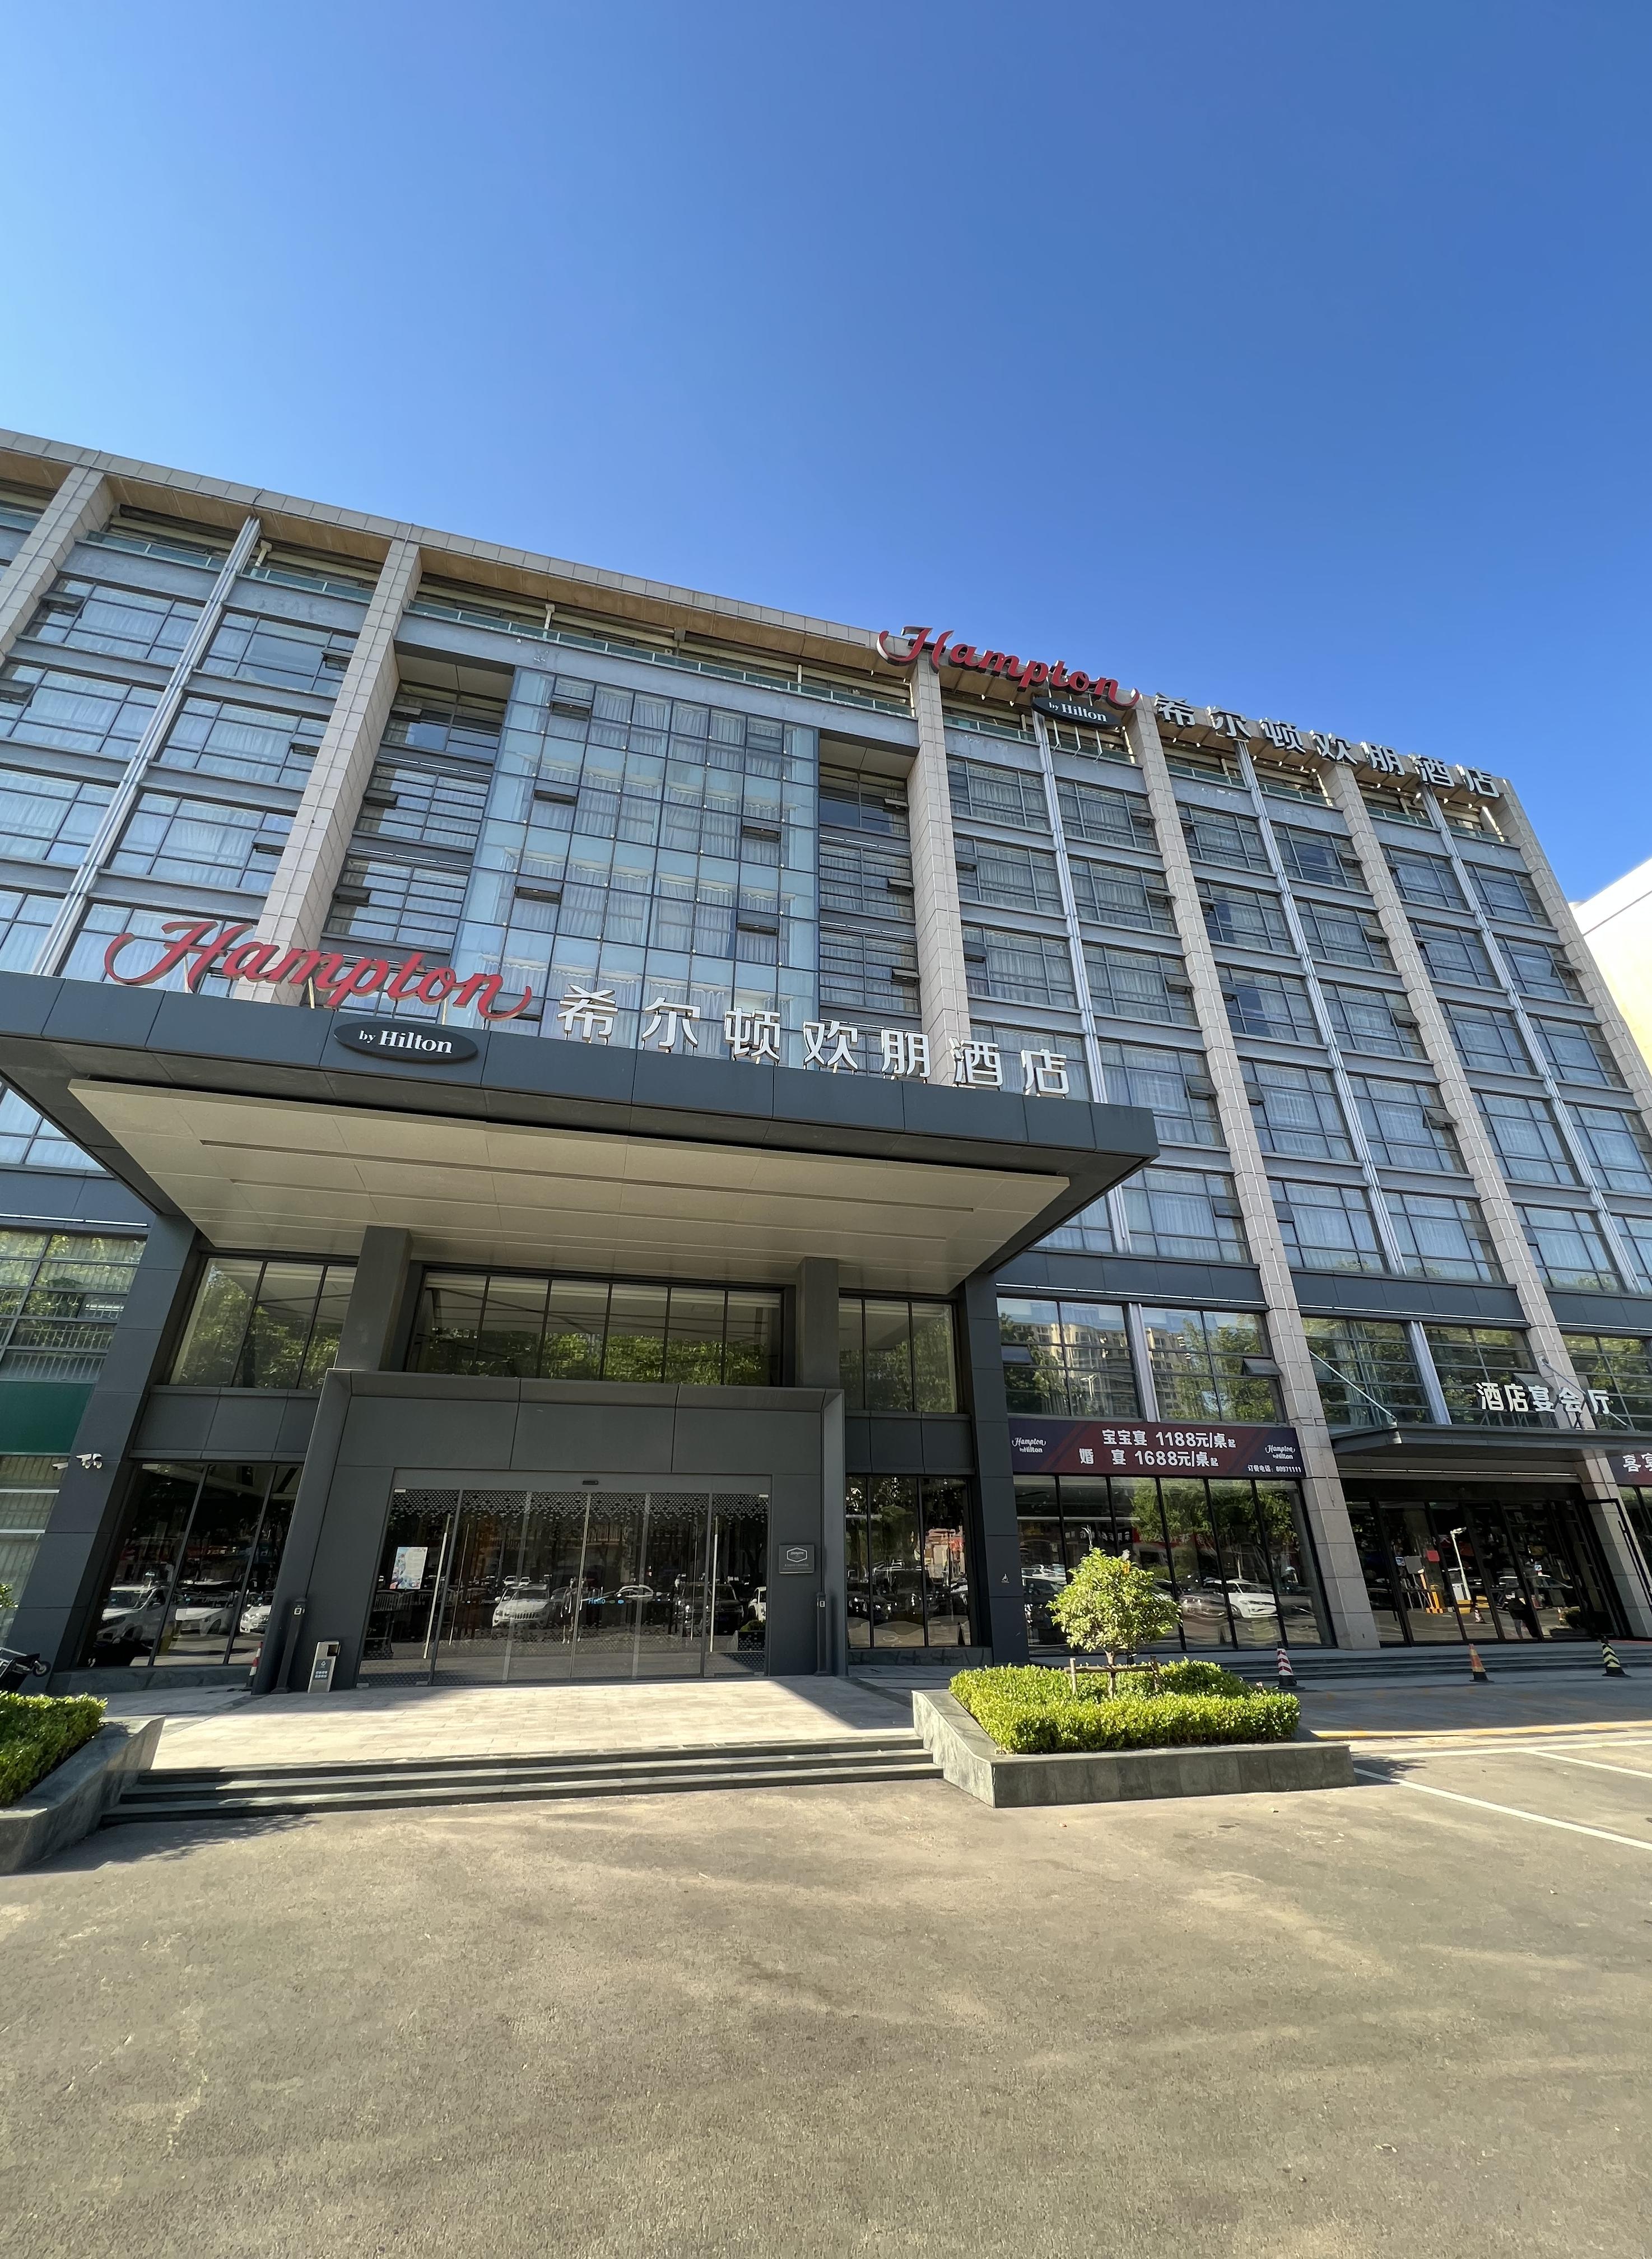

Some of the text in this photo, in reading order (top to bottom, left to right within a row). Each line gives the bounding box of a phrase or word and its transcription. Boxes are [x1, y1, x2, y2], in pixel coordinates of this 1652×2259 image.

[876, 626, 1140, 710] Hampton
[1049, 701, 1107, 722] by Hilton
[1154, 692, 1500, 798] 希尔顿欢朋酒店
[104, 921, 532, 1021] Hampton
[359, 1030, 452, 1054] by Hilton
[557, 984, 1070, 1099] 希尔顿欢朋酒店
[1476, 1382, 1610, 1415] 酒店宴会厅
[1011, 1437, 1046, 1447] Hampton
[1102, 1429, 1148, 1446] 宝宝宴
